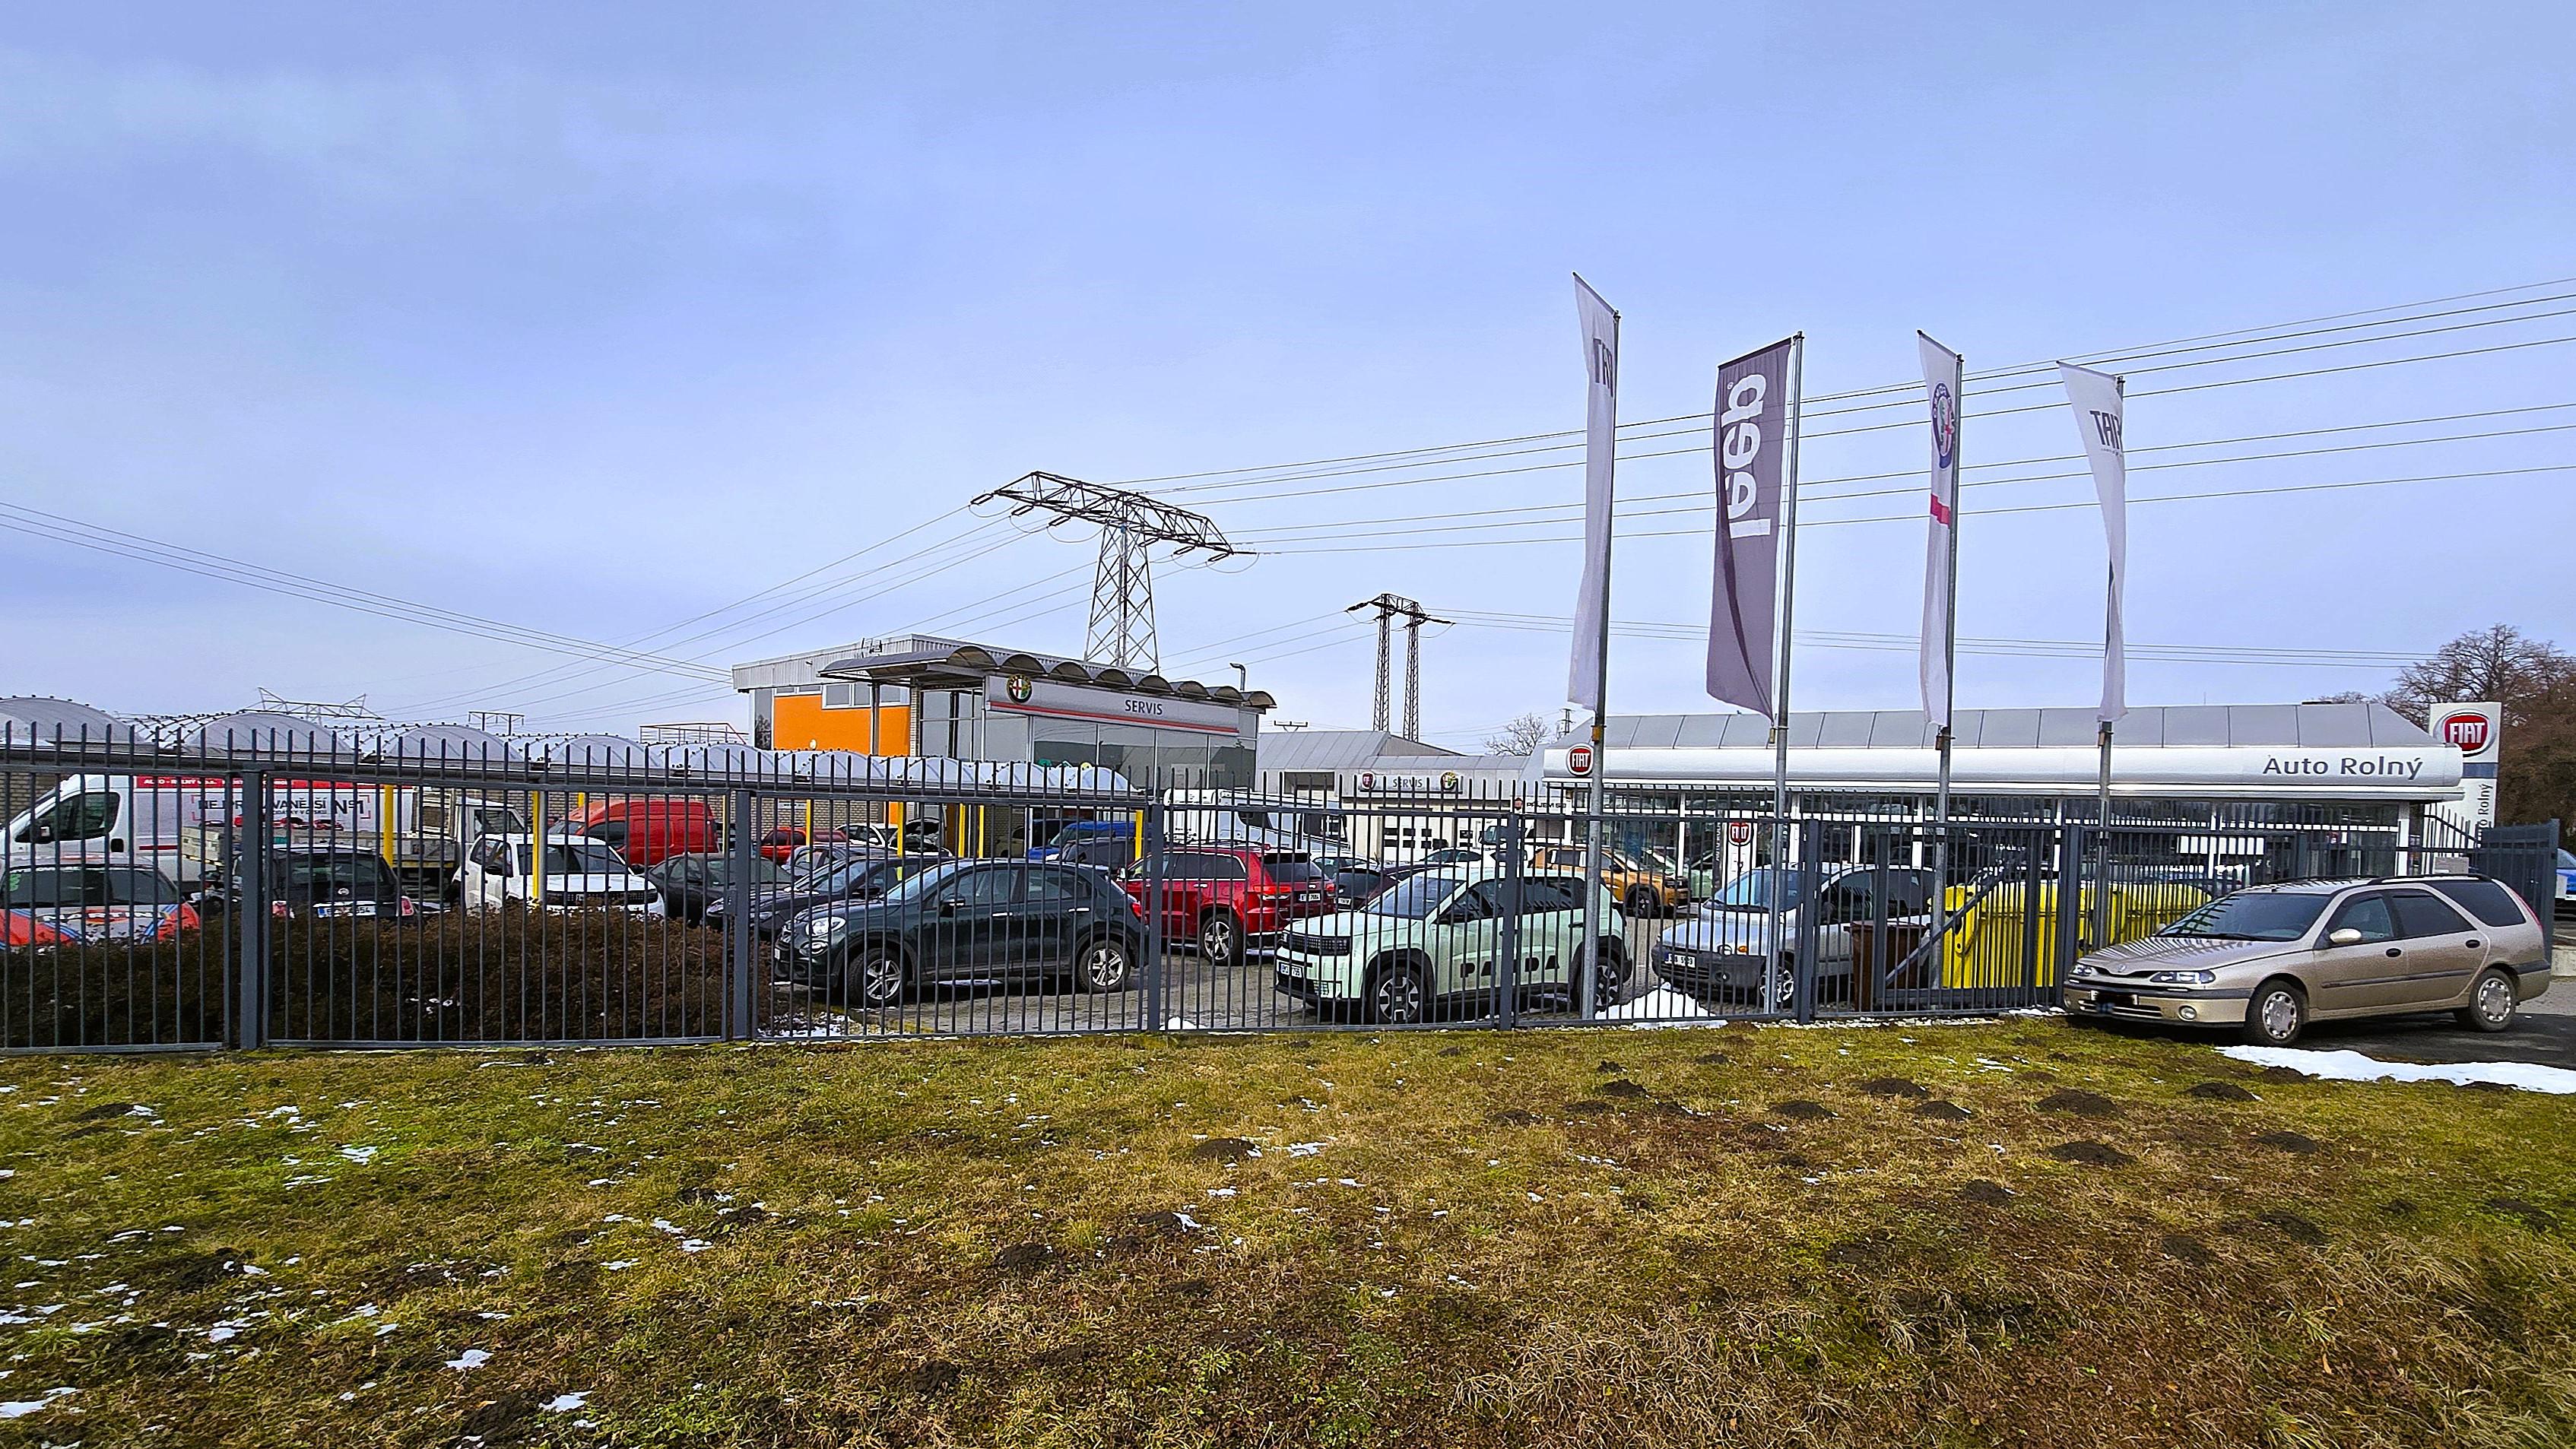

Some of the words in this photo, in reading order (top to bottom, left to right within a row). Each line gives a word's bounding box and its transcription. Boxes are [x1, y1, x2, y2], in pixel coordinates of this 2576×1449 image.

[1125, 699, 1163, 715] SERVIS
[2449, 722, 2486, 743] FIAT
[1572, 753, 1590, 768] FIAT
[2263, 758, 2328, 775] Auto
[2340, 756, 2423, 780] Rolný
[2477, 784, 2493, 815] Rolný
